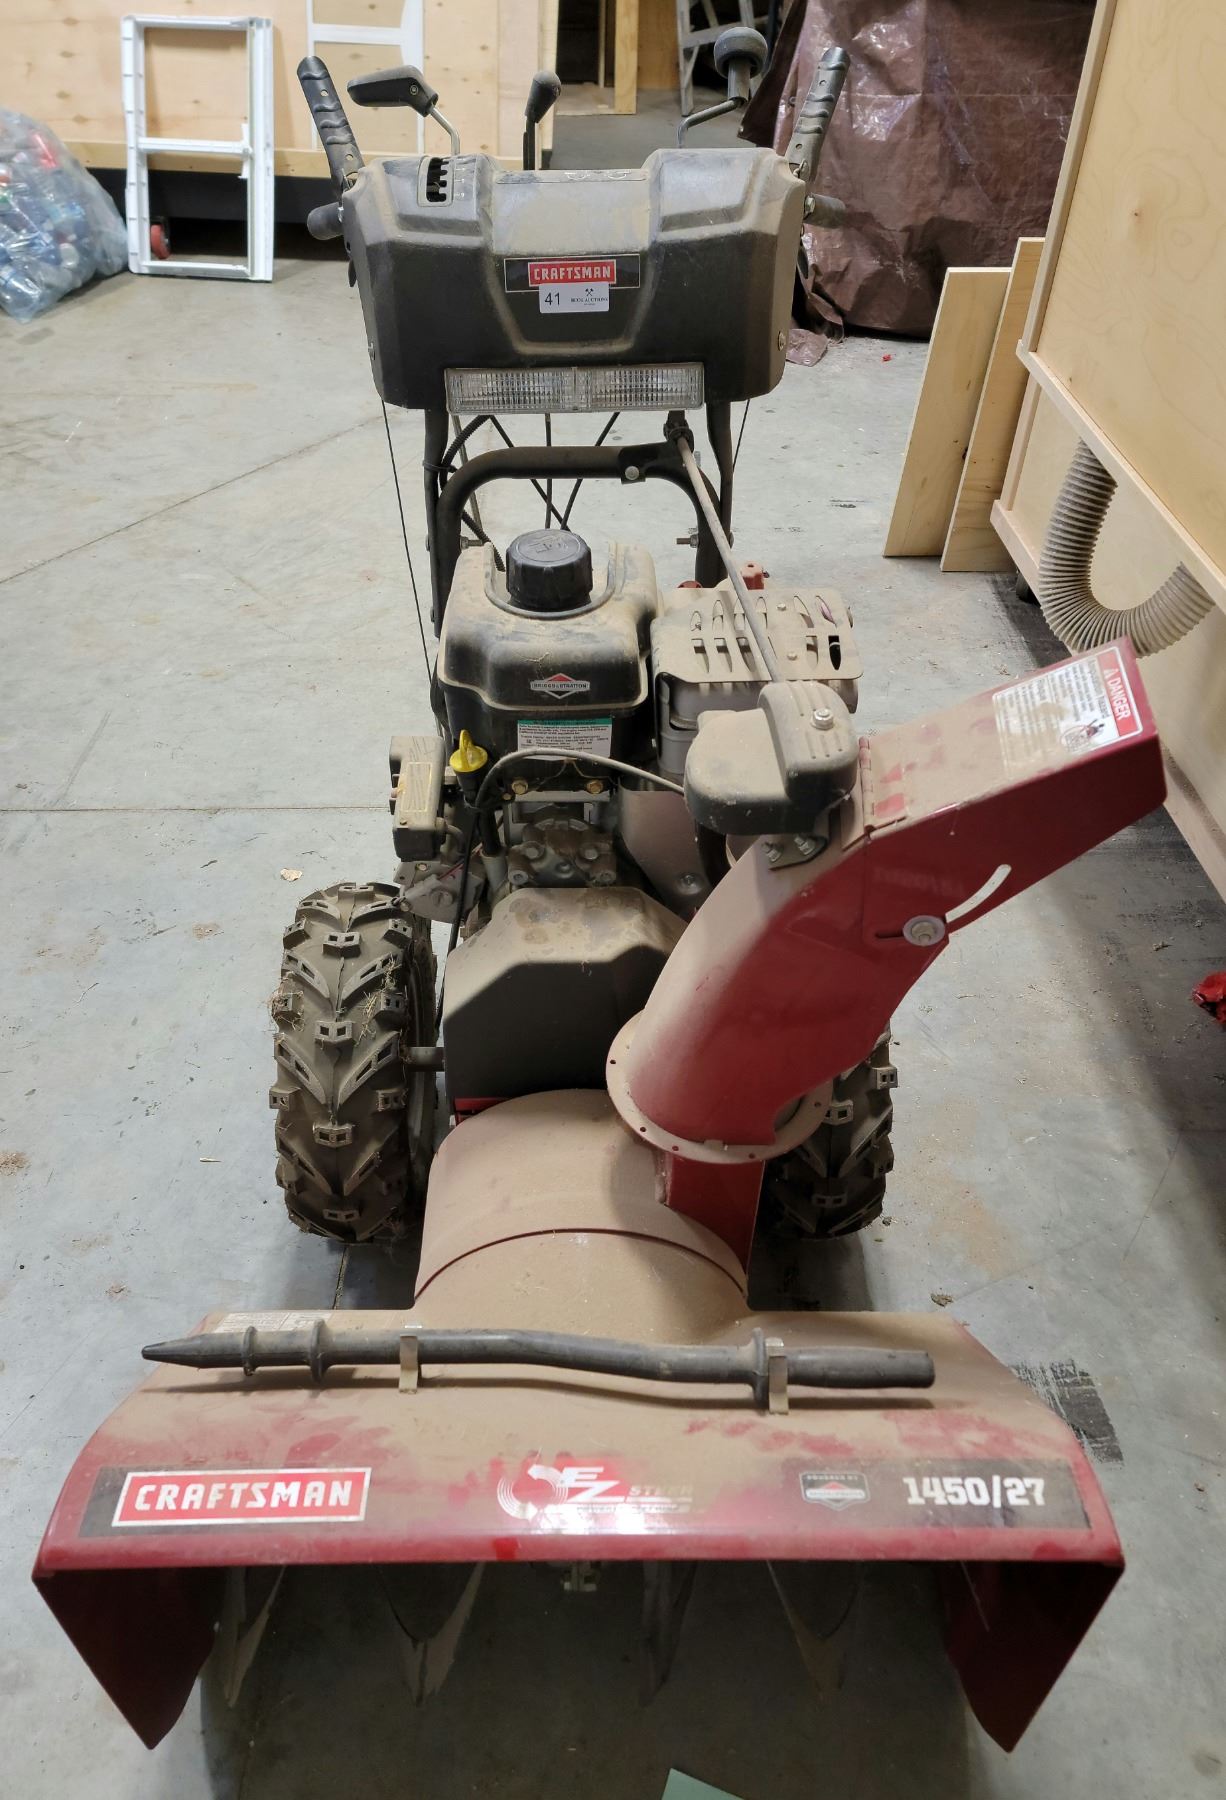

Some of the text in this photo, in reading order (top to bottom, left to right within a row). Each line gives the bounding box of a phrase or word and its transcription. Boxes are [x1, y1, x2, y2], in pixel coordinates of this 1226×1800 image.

[533, 266, 611, 280] CRAFTSMAN
[544, 292, 560, 306] 41
[1108, 677, 1131, 720] DANGER
[134, 1480, 353, 1511] CRAFTSMAN
